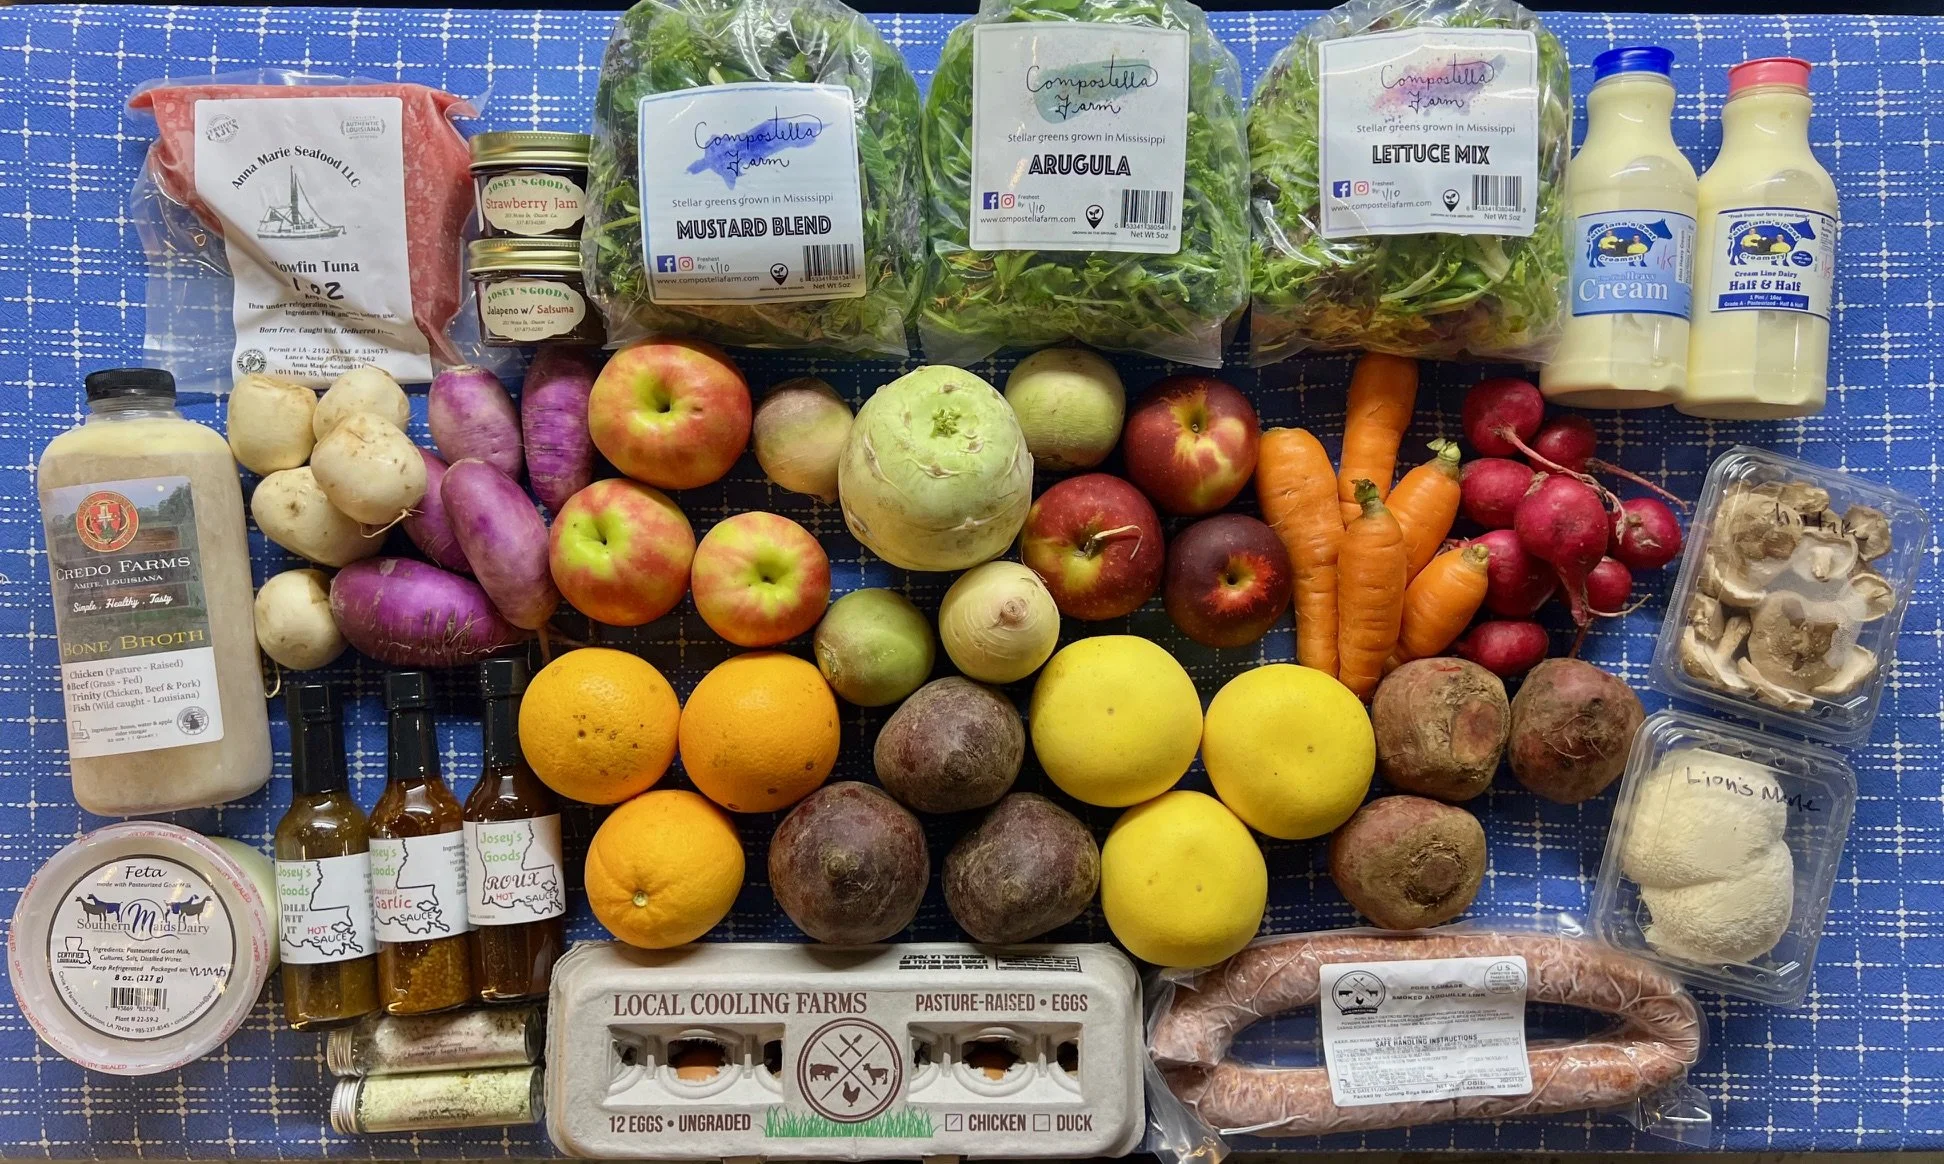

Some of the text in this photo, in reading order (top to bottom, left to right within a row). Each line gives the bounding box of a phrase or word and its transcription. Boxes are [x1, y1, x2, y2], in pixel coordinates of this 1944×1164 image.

[1027, 54, 1158, 95] Compostella
[1381, 53, 1494, 91] Compostella
[1055, 94, 1121, 120] Farm
[1408, 91, 1465, 114] Farm
[694, 105, 822, 150] Compostella
[1357, 123, 1516, 136] Stellar greens grown in Mississippi
[1008, 133, 1166, 147] Stellar greens grown in Mississippi
[1372, 144, 1490, 165] LETTUCE MIX
[232, 145, 361, 190] Anna Marie Seafood LLC
[724, 150, 790, 178] Farm
[1029, 154, 1132, 176] ARUGULA
[488, 177, 572, 195] JOSEY'S GOODS
[485, 197, 579, 212] Strawberry Jam
[672, 192, 834, 208] Stellar greens grown in Mississippi
[1331, 200, 1432, 213] www.compostellafarm.com
[981, 216, 1076, 225] www.compostellafarm.com
[1508, 213, 1521, 221] 5oz
[676, 215, 832, 240] MUSTARD BLEND
[1156, 231, 1169, 239] 5oz
[1638, 223, 1658, 242] Best
[1782, 221, 1801, 241] Best
[1599, 253, 1643, 264] Creamery
[1740, 252, 1786, 261] Creamery
[322, 260, 360, 273] Tuna
[656, 274, 760, 286] www.compostellafarm.com
[1627, 271, 1657, 281] Heavy
[1734, 270, 1758, 278] Cream
[1778, 270, 1797, 279] Dairy
[1579, 278, 1669, 302] Cream
[1729, 279, 1802, 292] Half & Half
[488, 286, 570, 303] JOSEY'S GOODS
[266, 302, 286, 310] under
[289, 301, 328, 309] refrigeration
[322, 309, 336, 317] Fish
[487, 304, 575, 318] Jalapeno w/ Satsuma
[299, 327, 323, 335] Caught
[341, 327, 376, 335] Delivered
[57, 556, 191, 581] CREDO FARMS
[73, 573, 163, 591] AMITE, LOUISIANA
[73, 592, 173, 614] Simple Healthy Tasty
[64, 630, 204, 657] BONE BROTH
[69, 659, 184, 680] Chicken (Pasture Raised)
[71, 675, 143, 690] Beef (Grass Fed)
[72, 677, 201, 703] Trinity (Chicken, Beef & Pork)
[73, 690, 200, 713] Fish (Wild caught Louisiana)
[1686, 766, 1754, 797] Lion's
[480, 830, 523, 847] Josey's
[484, 848, 521, 862] Goods
[124, 865, 168, 880] Feta
[128, 881, 167, 889] Pasteurized
[486, 871, 541, 890] ROUX
[280, 884, 310, 896] Goods
[496, 892, 514, 901] HOT
[525, 891, 555, 904] SAUCE
[284, 904, 309, 912] DILL
[375, 894, 413, 910] Garlic
[284, 915, 304, 923] WIT
[400, 911, 433, 923] SAUCE
[77, 918, 131, 932] Southern
[178, 920, 210, 934] Dairy
[287, 926, 297, 934] IT
[307, 925, 328, 935] HOT
[313, 933, 347, 944] SAUCE
[57, 951, 85, 959] CERTIFIED
[93, 946, 125, 954] Ingredients:
[108, 965, 144, 973] Refrigerated
[151, 966, 178, 974] Packaged
[136, 974, 155, 982] (227
[156, 974, 164, 984] g)
[614, 991, 867, 1017] LOCAL COOLING FARMS
[915, 992, 1089, 1013] PASTURE-RAISED EGGS
[1376, 1040, 1391, 1048] SAFE
[1394, 1038, 1428, 1047] HANDLING
[1429, 1034, 1478, 1045] INSTRUCTIONS
[609, 1113, 752, 1134] 12 EGGS UNGRADED
[969, 1113, 1094, 1133] CHICKEN DUCK
